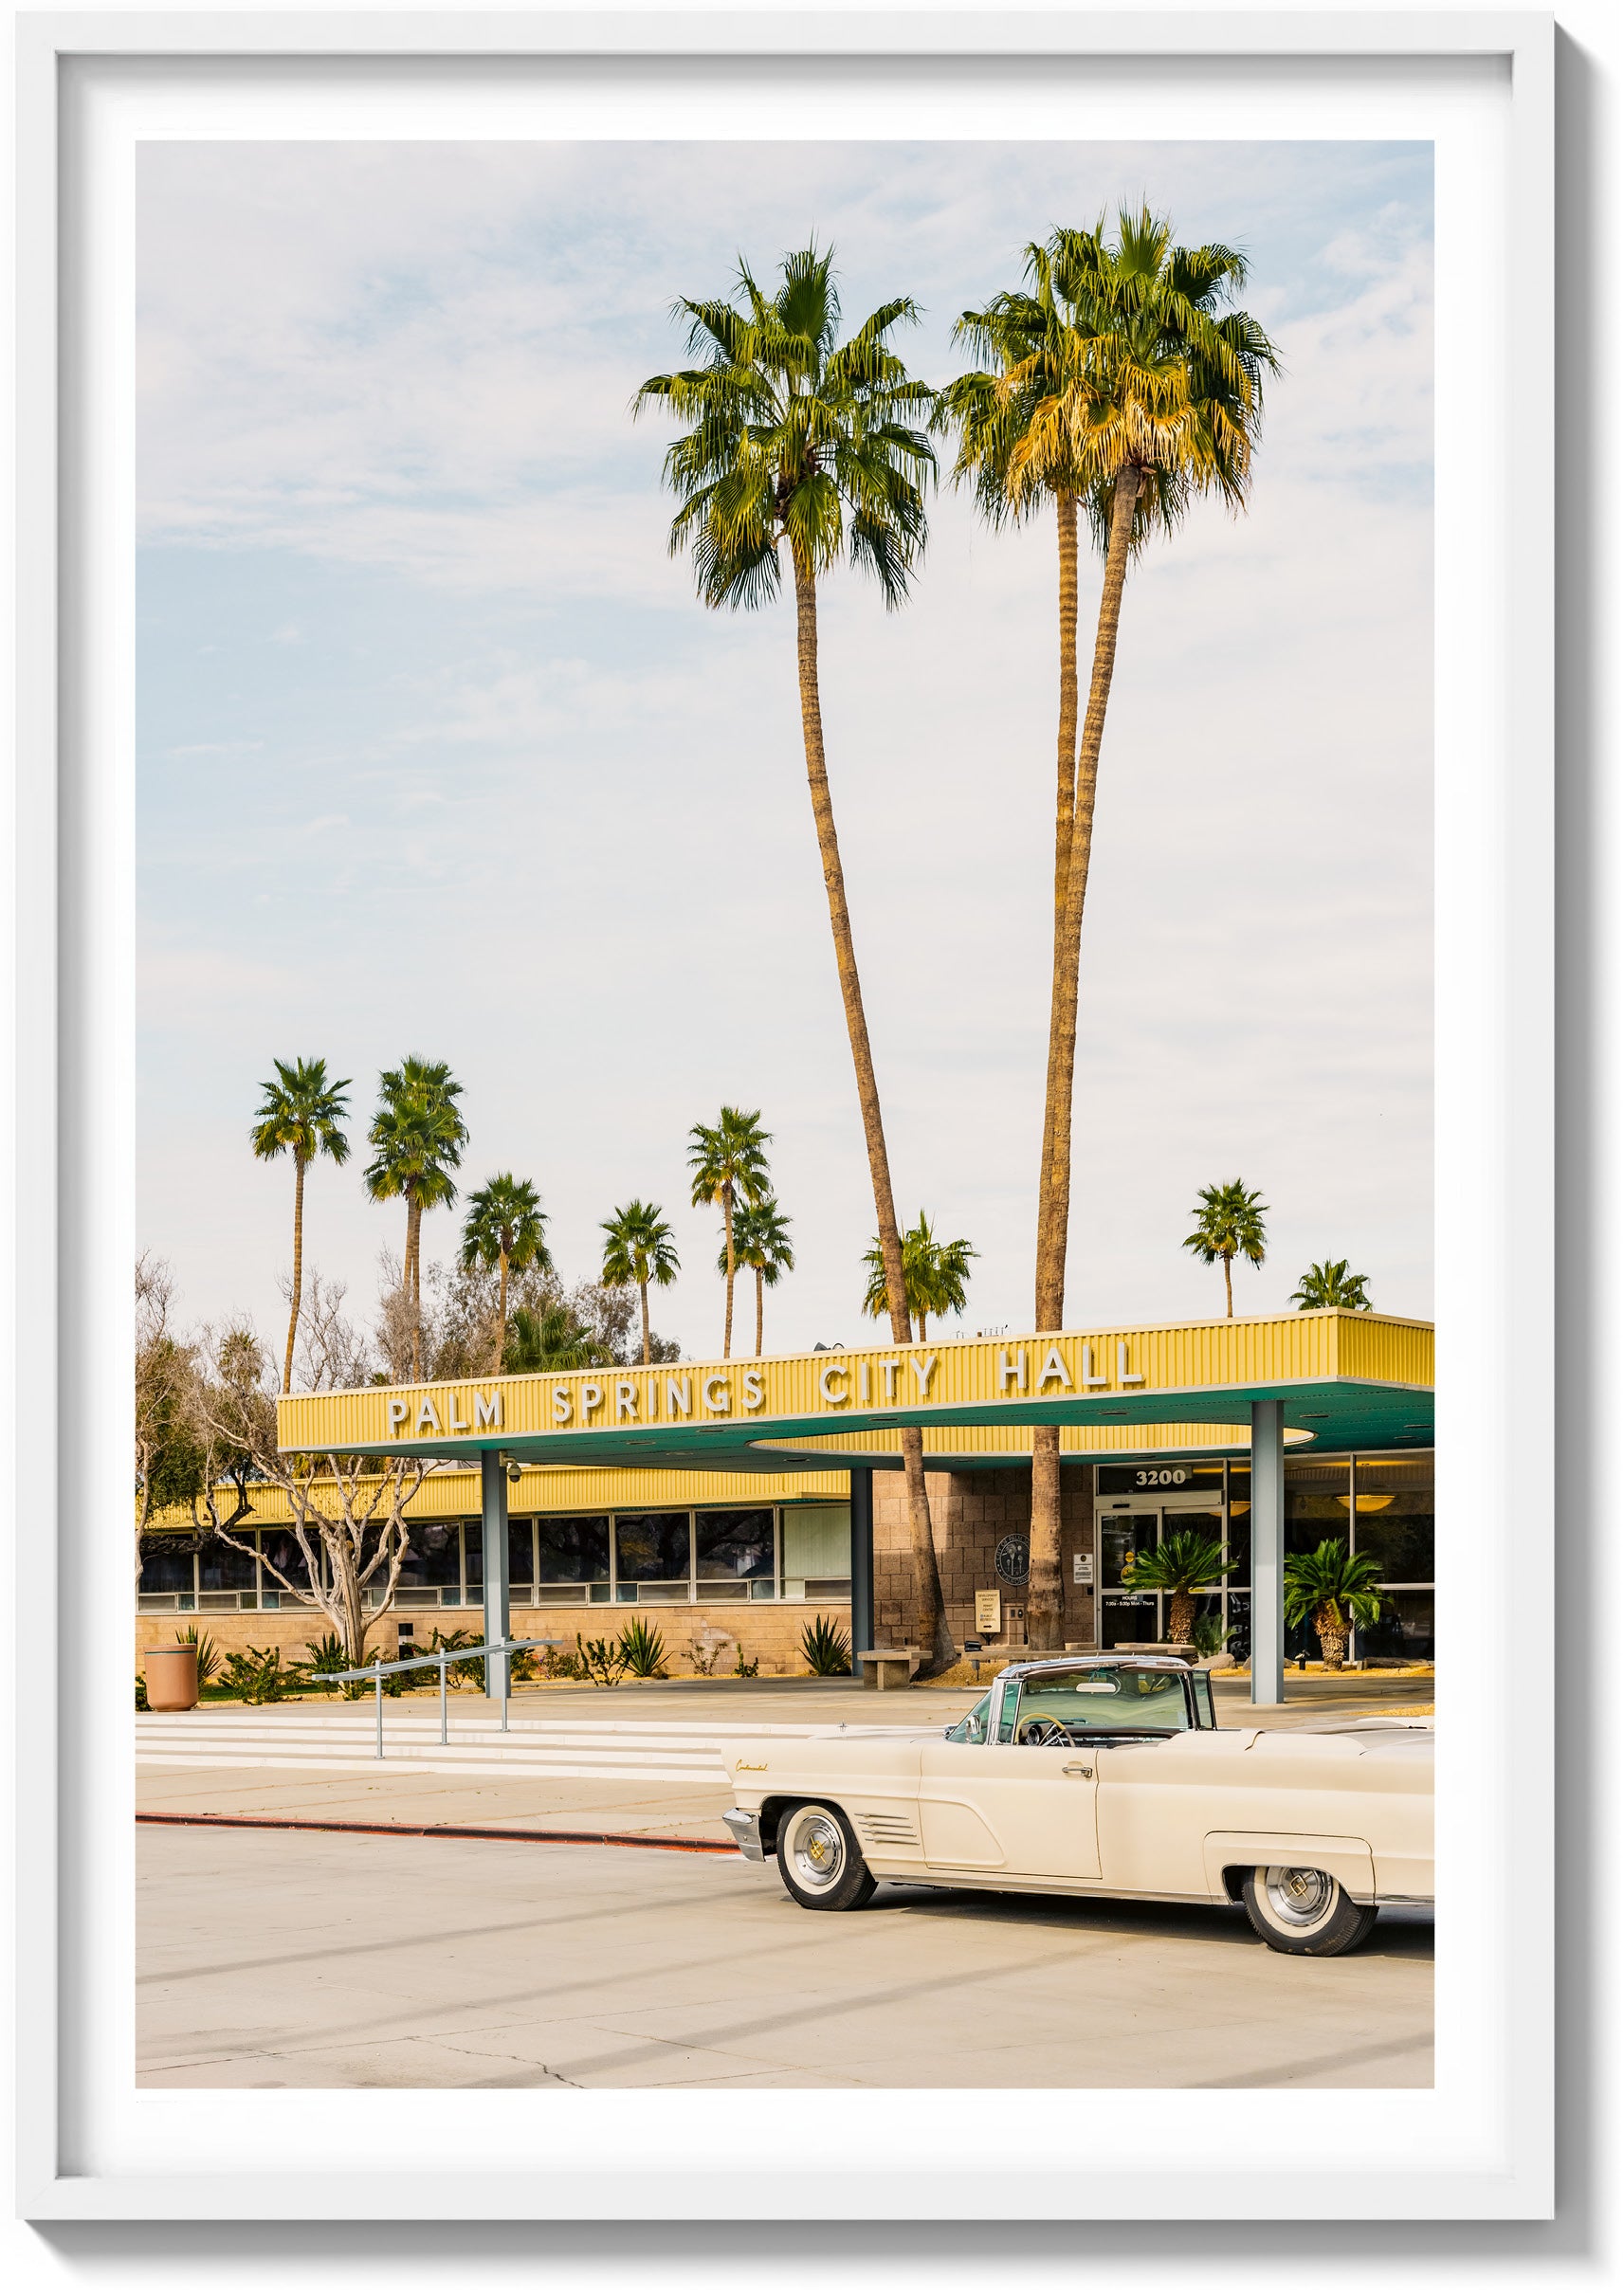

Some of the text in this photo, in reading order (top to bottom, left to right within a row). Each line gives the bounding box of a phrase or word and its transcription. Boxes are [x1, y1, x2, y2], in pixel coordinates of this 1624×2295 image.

[388, 1341, 1144, 1434] PALM SPRINGS CITY HALL
[1136, 1469, 1186, 1485] 3200
[736, 1758, 769, 1773] Continental
